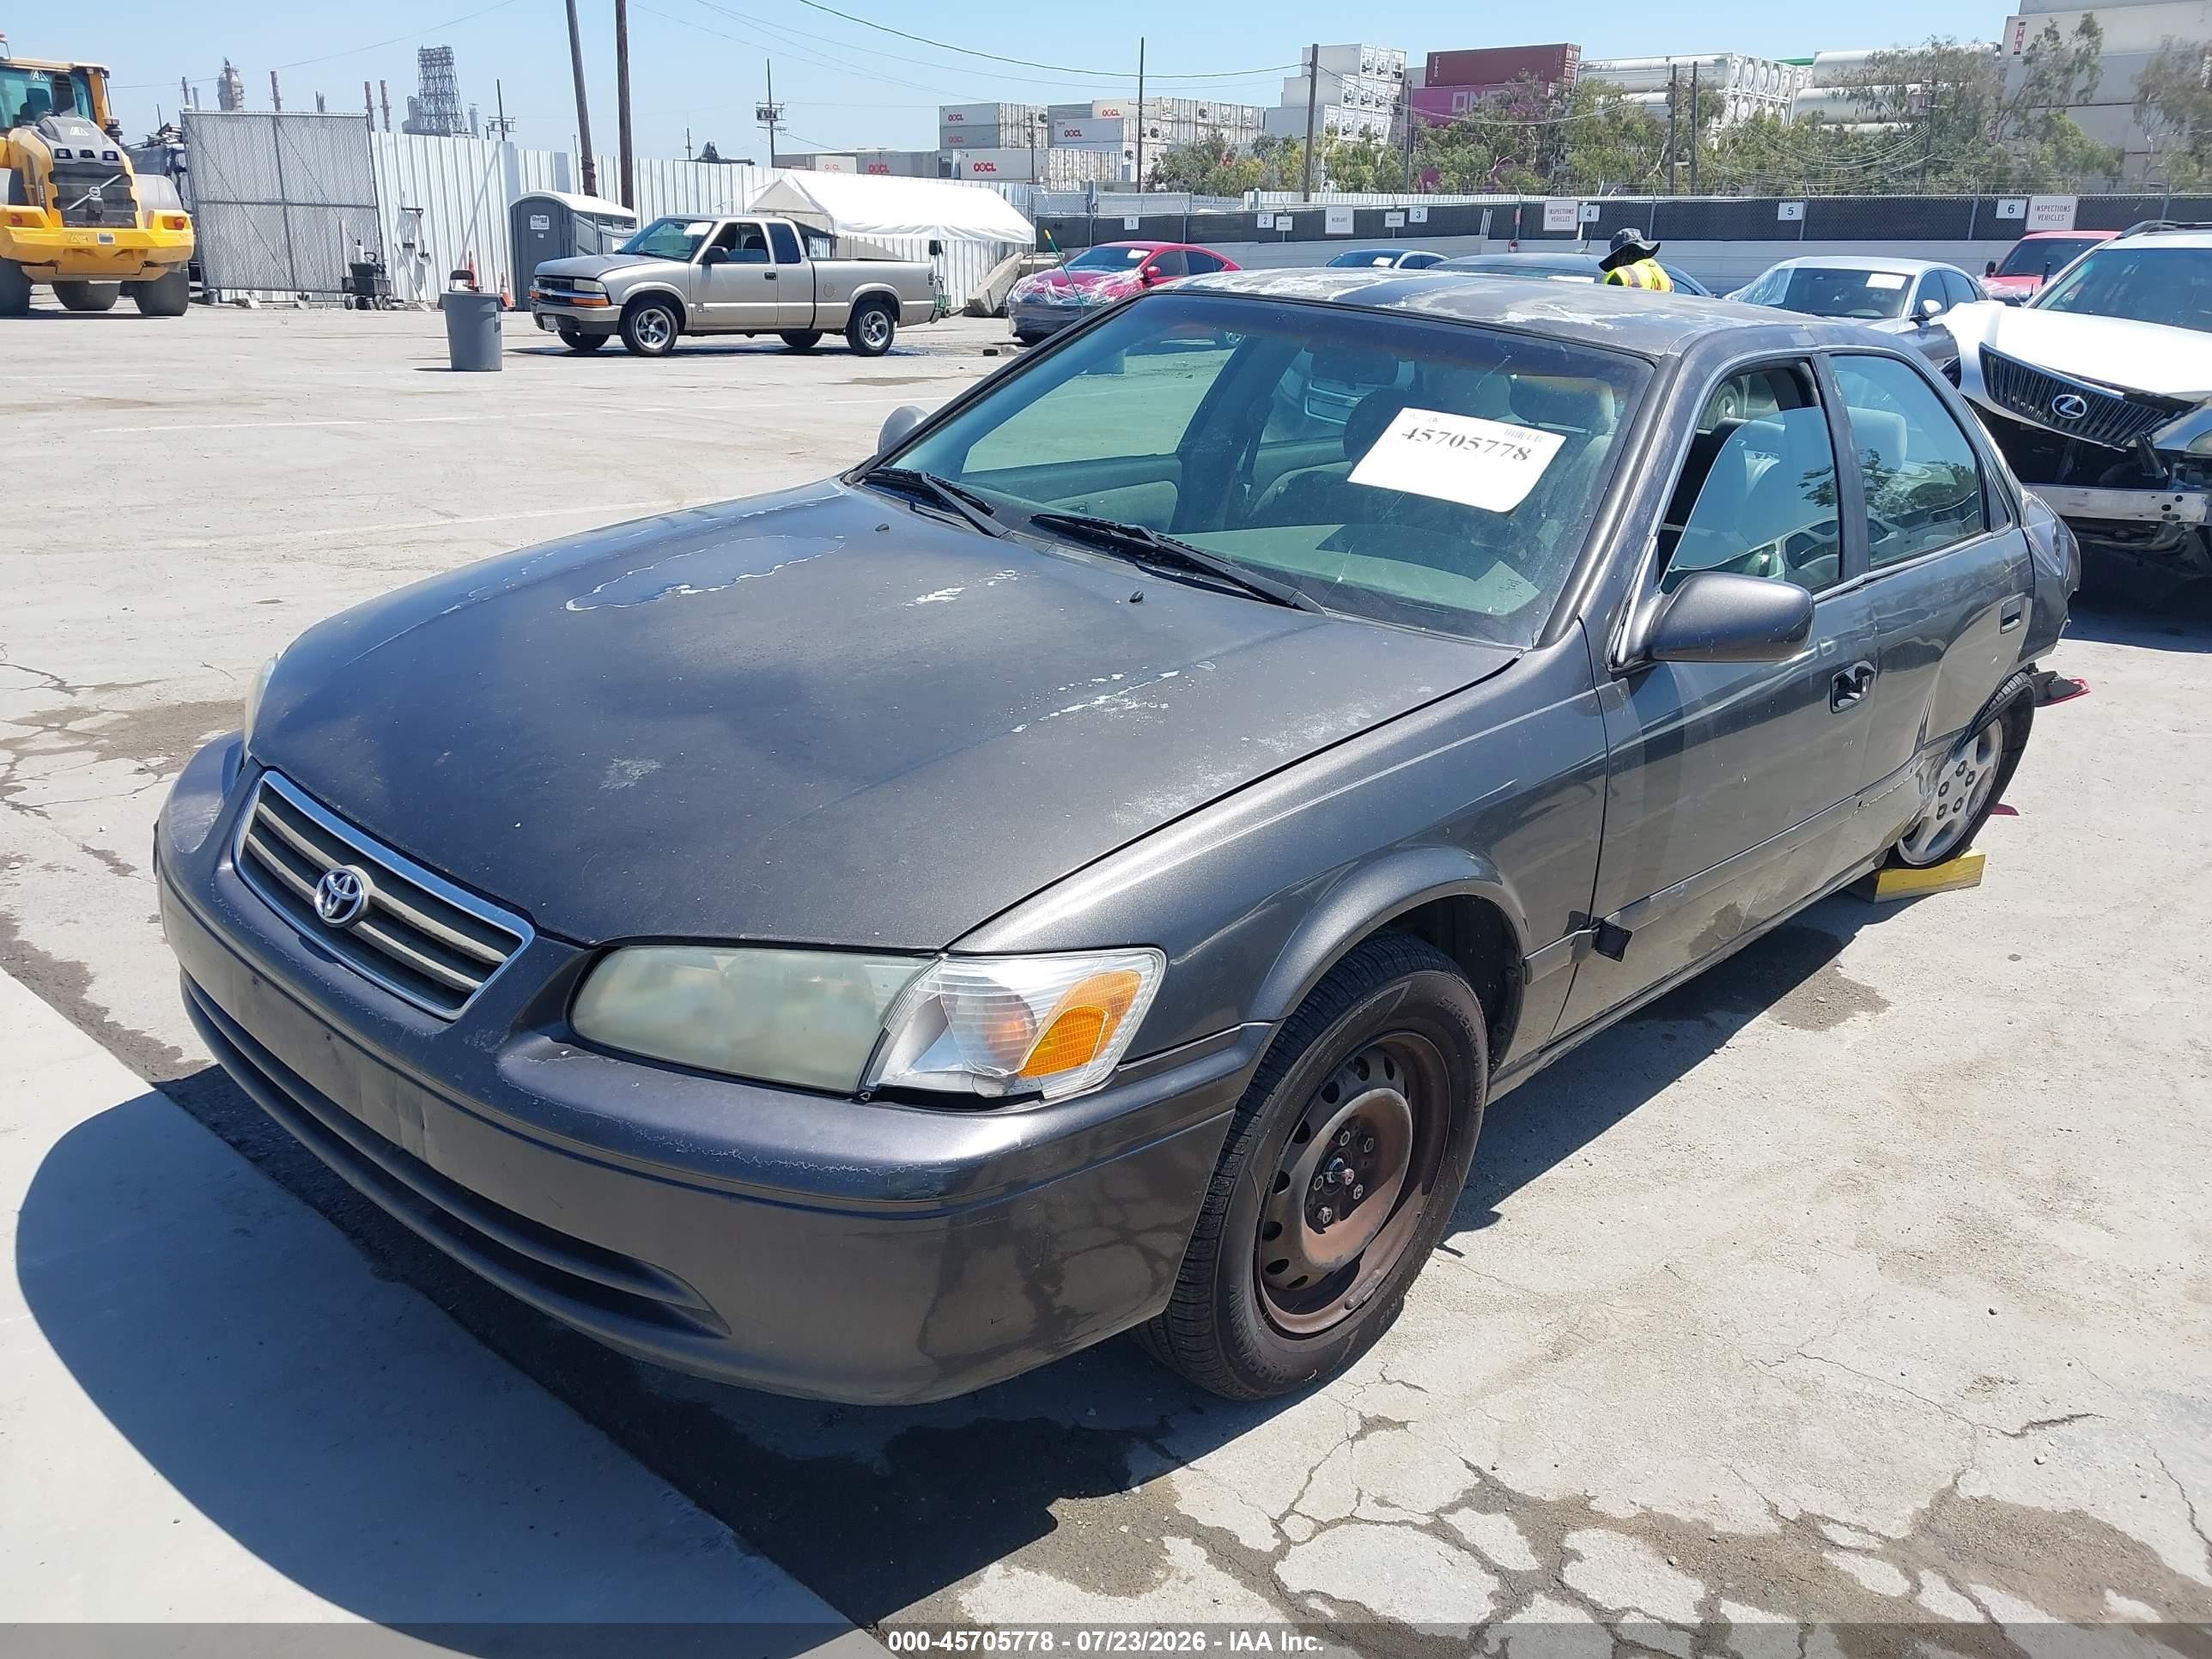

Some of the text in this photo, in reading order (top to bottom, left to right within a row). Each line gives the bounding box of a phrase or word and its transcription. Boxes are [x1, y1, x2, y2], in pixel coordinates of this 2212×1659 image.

[1064, 129, 1083, 137] OOCL
[868, 164, 890, 173] OOCL
[974, 162, 996, 172] OOCL
[1586, 209, 1592, 217] 4
[1787, 206, 1794, 216] 5
[2008, 204, 2014, 214] 6
[1415, 210, 1421, 219] 3
[1262, 216, 1267, 225] 2
[1401, 427, 1532, 461] 45705778
